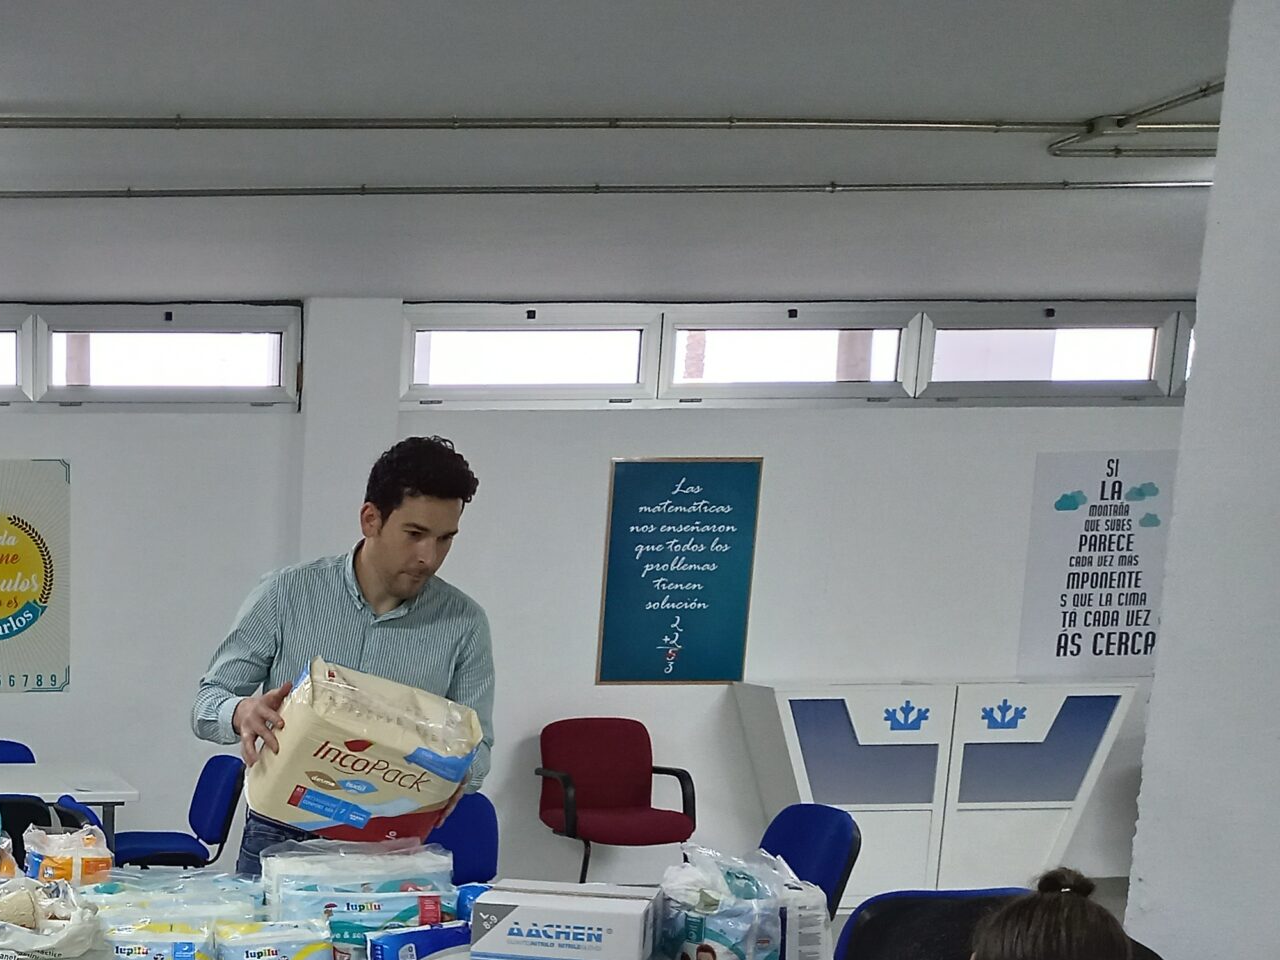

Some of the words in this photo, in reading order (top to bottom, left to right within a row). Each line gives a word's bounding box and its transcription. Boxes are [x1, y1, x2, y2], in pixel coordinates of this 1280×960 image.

[1106, 458, 1119, 477] SI
[671, 477, 703, 495] Las
[1100, 480, 1122, 501] LA
[638, 499, 733, 514] matemáticas
[629, 523, 657, 533] nos
[660, 521, 738, 533] enseñaron
[1084, 519, 1100, 532] QUE
[1104, 519, 1132, 532] SUBES
[634, 542, 665, 560] que
[665, 538, 706, 552] todos
[710, 537, 731, 552] los
[1078, 534, 1135, 552] PARECE
[641, 556, 718, 577] problemas
[1069, 555, 1093, 567] CADA
[1097, 554, 1114, 567] VEZ
[653, 577, 704, 591] tienen
[1066, 571, 1143, 589] MPONENTE
[6, 597, 21, 609] es
[645, 595, 710, 610] solución
[1060, 594, 1067, 607] S
[1072, 593, 1094, 607] QUE
[1099, 593, 1112, 607] LA
[1117, 592, 1147, 606] CIMA
[1084, 610, 1119, 627] CADA
[1126, 609, 1151, 626] VEZ
[1056, 629, 1082, 657] ÁS
[1092, 631, 1157, 656] CERCA
[313, 740, 431, 792] IncoPack
[346, 902, 381, 912] lupilu
[507, 922, 602, 943] AACHEN
[115, 945, 149, 956] lupilu
[245, 948, 278, 959] lupilu
